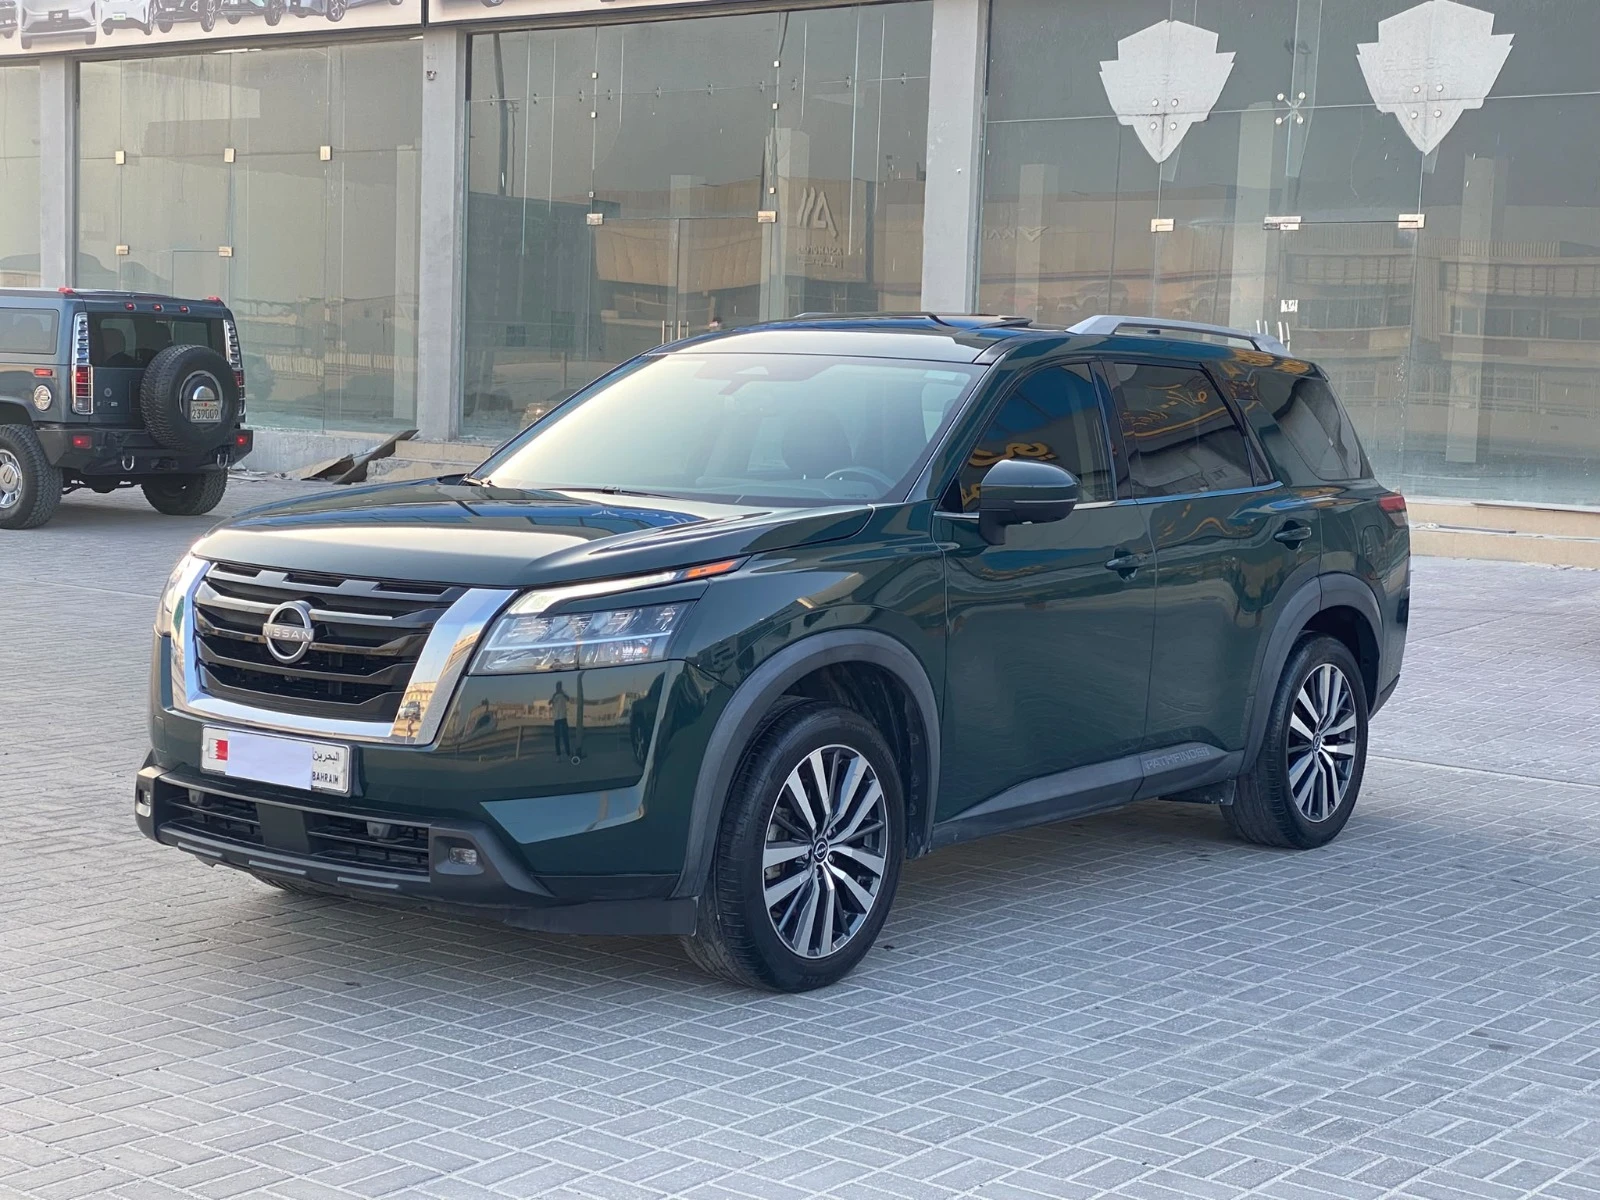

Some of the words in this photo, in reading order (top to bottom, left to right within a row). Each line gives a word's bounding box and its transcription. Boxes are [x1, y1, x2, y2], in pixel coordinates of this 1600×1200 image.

[263, 625, 312, 640] NISSAN
[312, 751, 340, 765] البحرين
[1145, 746, 1210, 770] PATHFINDER
[312, 771, 339, 785] BAHRAIN
